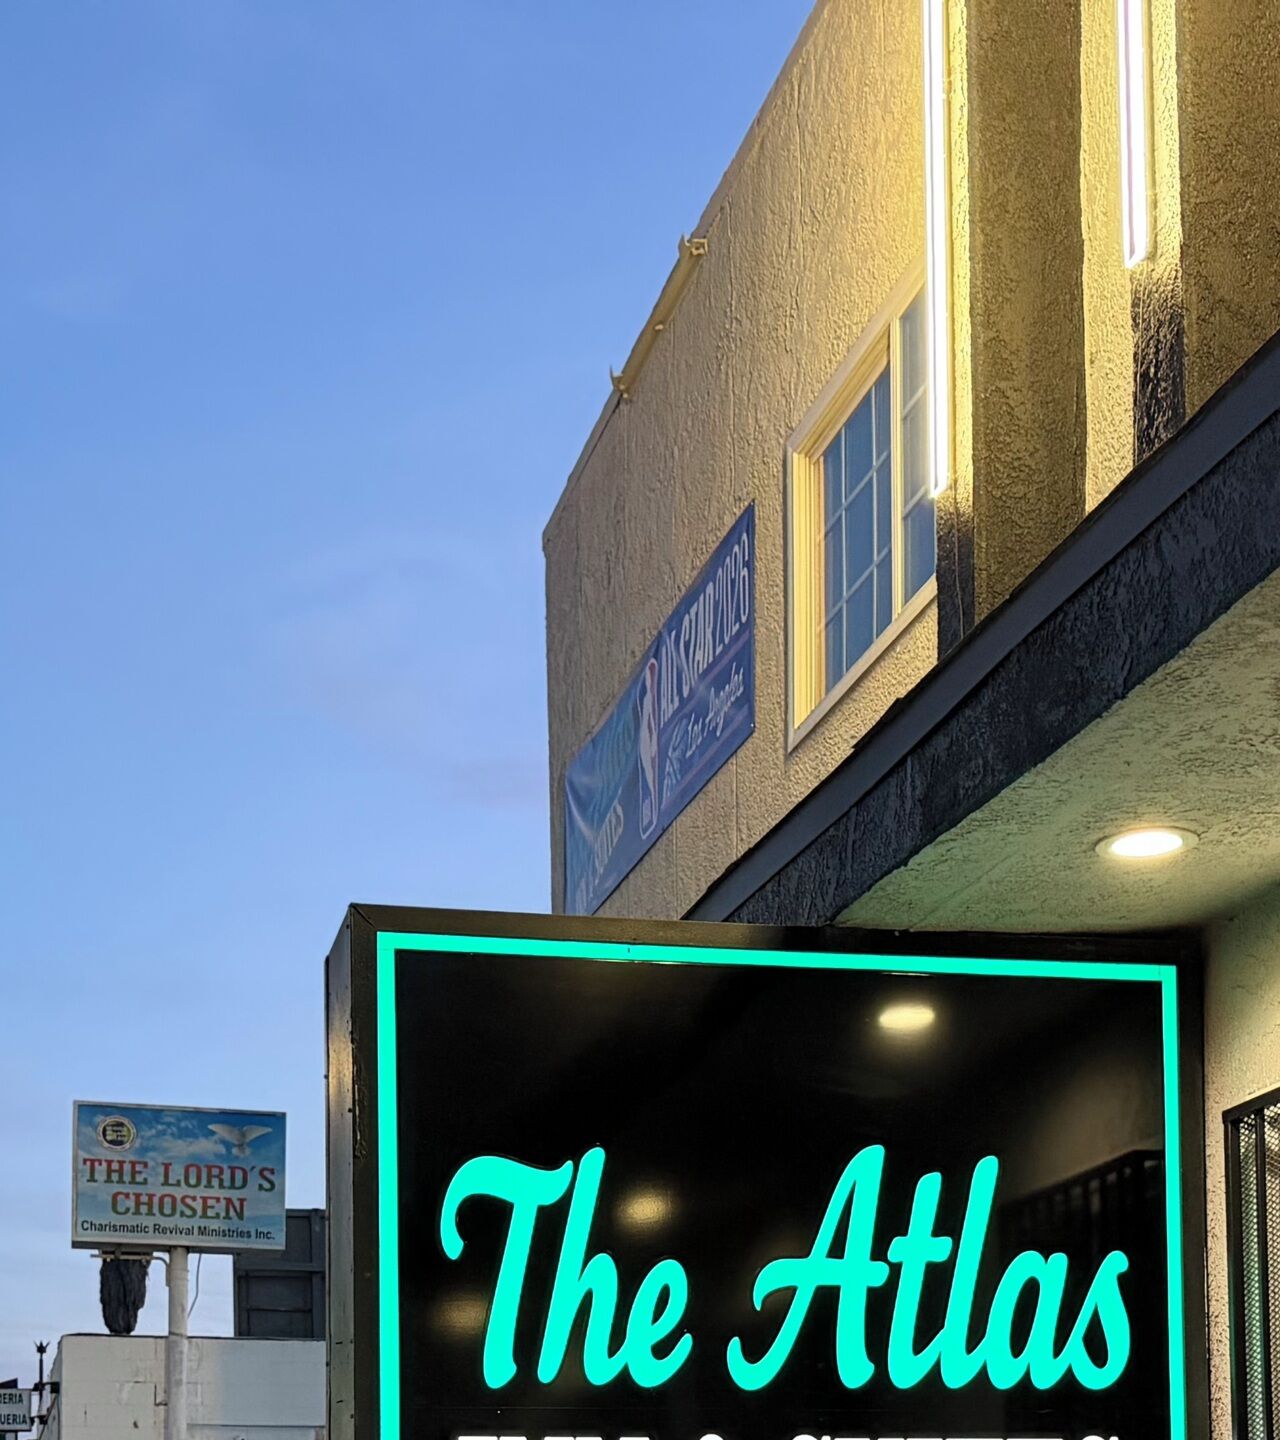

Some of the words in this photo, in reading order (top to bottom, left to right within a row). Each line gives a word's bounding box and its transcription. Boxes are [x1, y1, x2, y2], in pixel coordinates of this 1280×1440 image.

[660, 630, 679, 729] ALL
[679, 581, 714, 698] STAR
[715, 532, 749, 656] 2026
[685, 712, 703, 759] Los
[704, 661, 744, 737] Angeles
[83, 1158, 148, 1185] THE
[81, 1220, 150, 1234] Charismatic
[153, 1224, 195, 1236] Revival
[197, 1225, 252, 1239] Ministries
[255, 1228, 276, 1240] Inc.
[111, 1191, 247, 1221] CHOSEN
[440, 1146, 693, 1389] The
[726, 1144, 1131, 1391] Atlas
